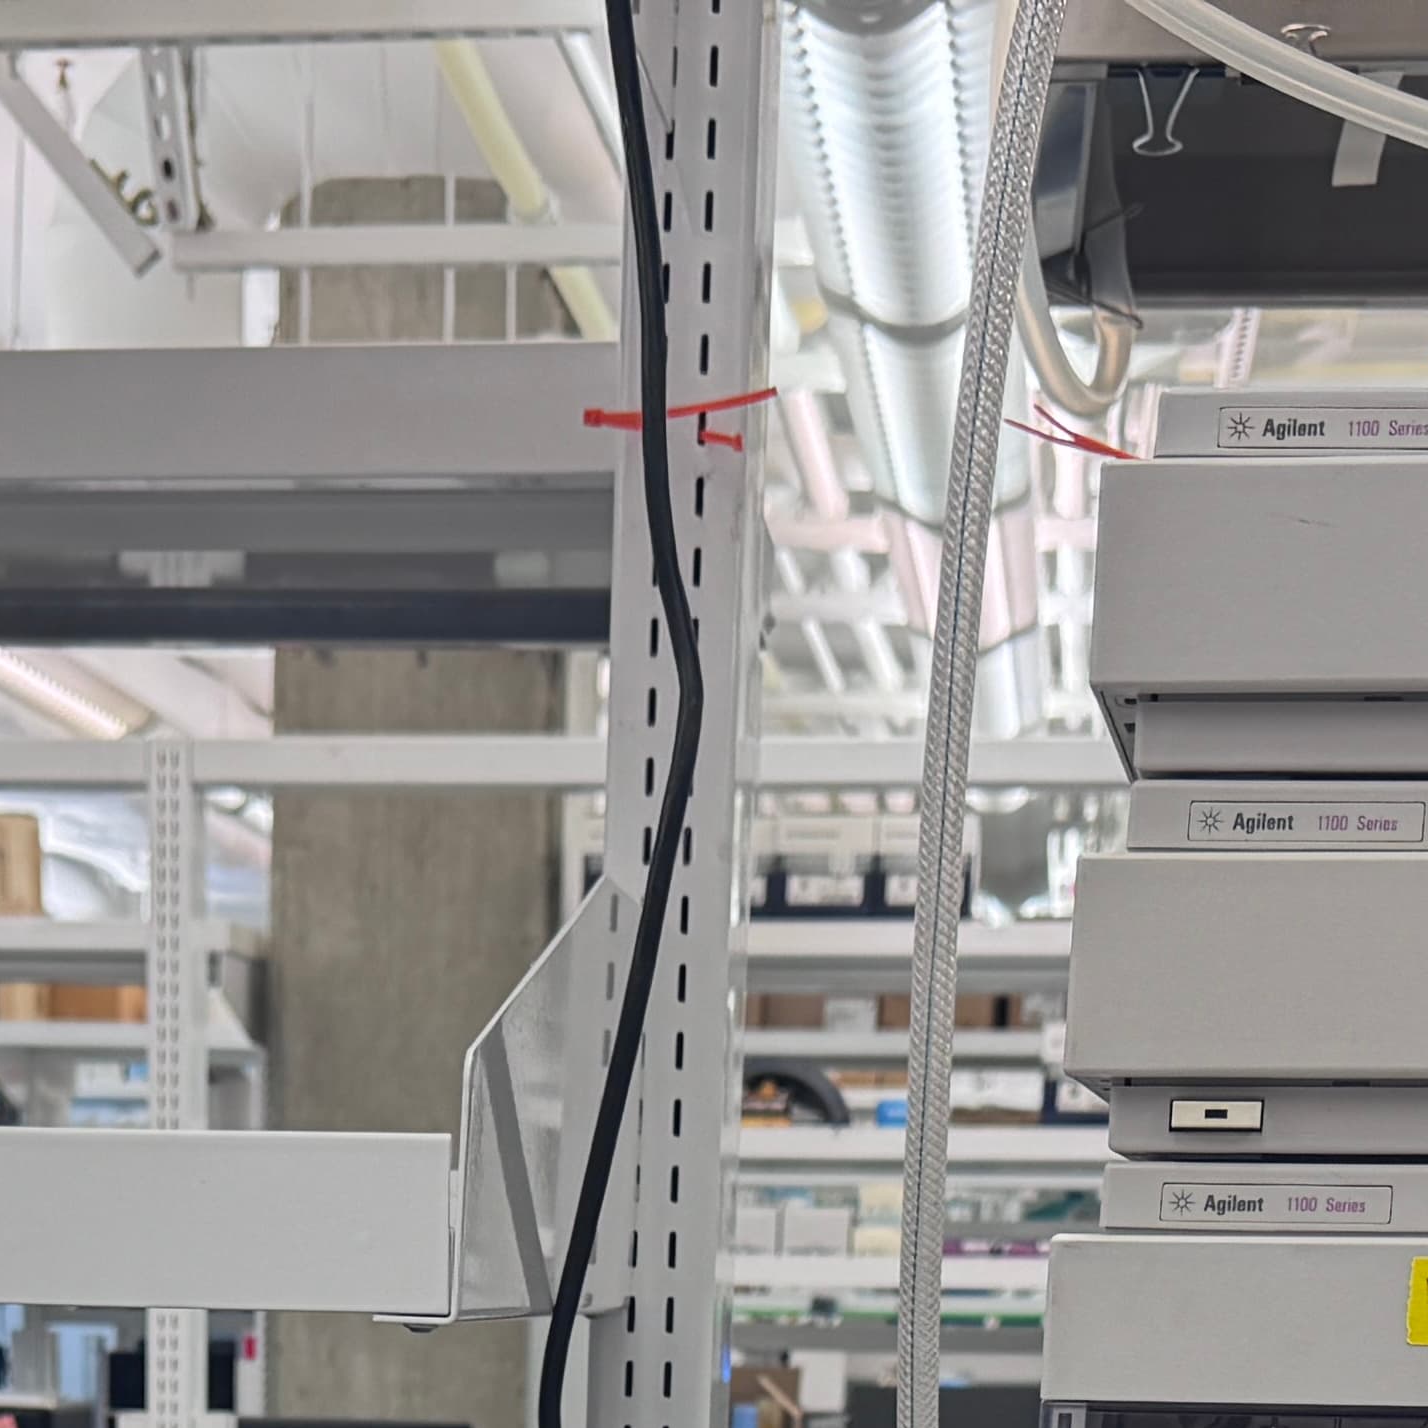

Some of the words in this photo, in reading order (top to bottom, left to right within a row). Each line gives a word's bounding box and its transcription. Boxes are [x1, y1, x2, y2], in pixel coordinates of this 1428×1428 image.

[1263, 419, 1325, 441] Agilent
[1348, 420, 1380, 438] 1100
[1233, 812, 1294, 835] Agilent
[1317, 815, 1349, 831] 1100
[1357, 815, 1398, 832] Series
[1203, 1194, 1264, 1216] Agilent
[1287, 1196, 1317, 1213] 1100
[1325, 1197, 1366, 1214] Series
